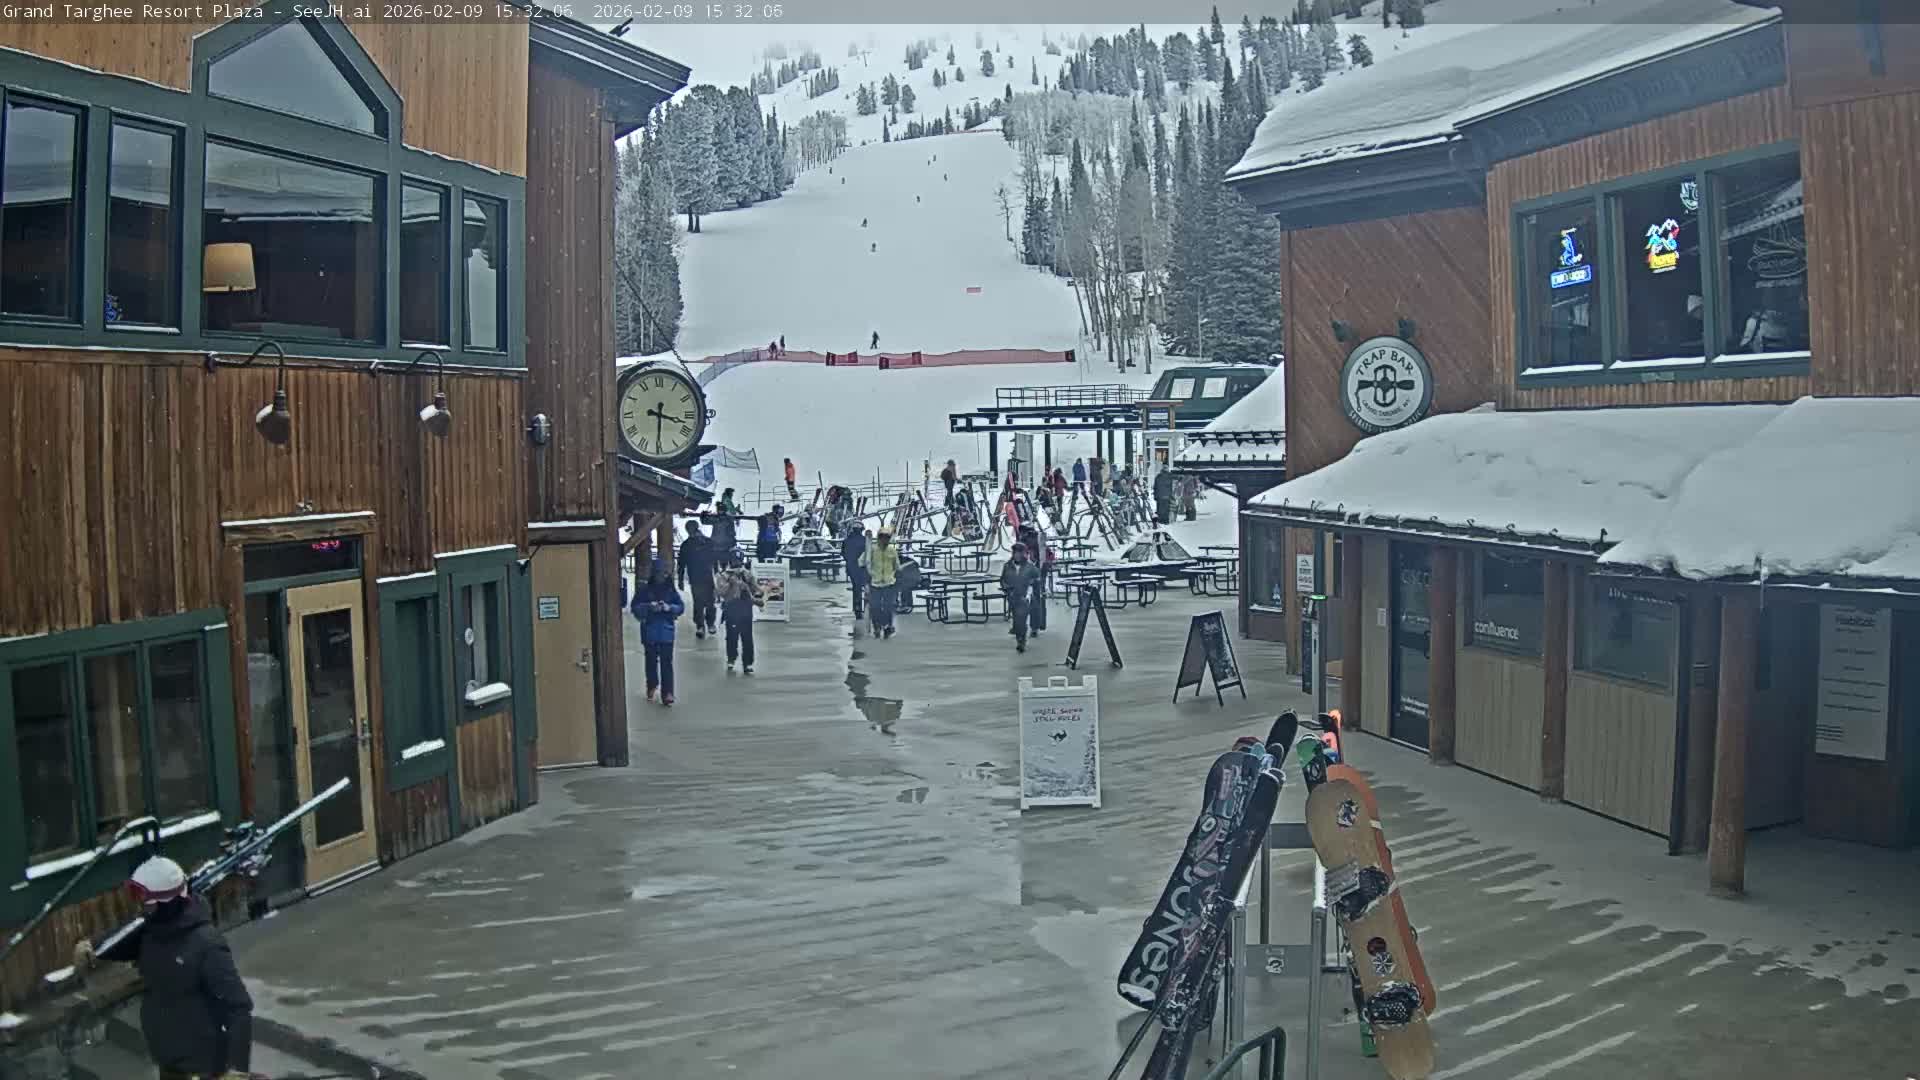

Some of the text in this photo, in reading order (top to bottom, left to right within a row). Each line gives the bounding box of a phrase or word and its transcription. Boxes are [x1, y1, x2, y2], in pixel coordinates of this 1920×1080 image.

[1356, 349, 1414, 376] TRAP BAR
[1474, 621, 1520, 640] confluence
